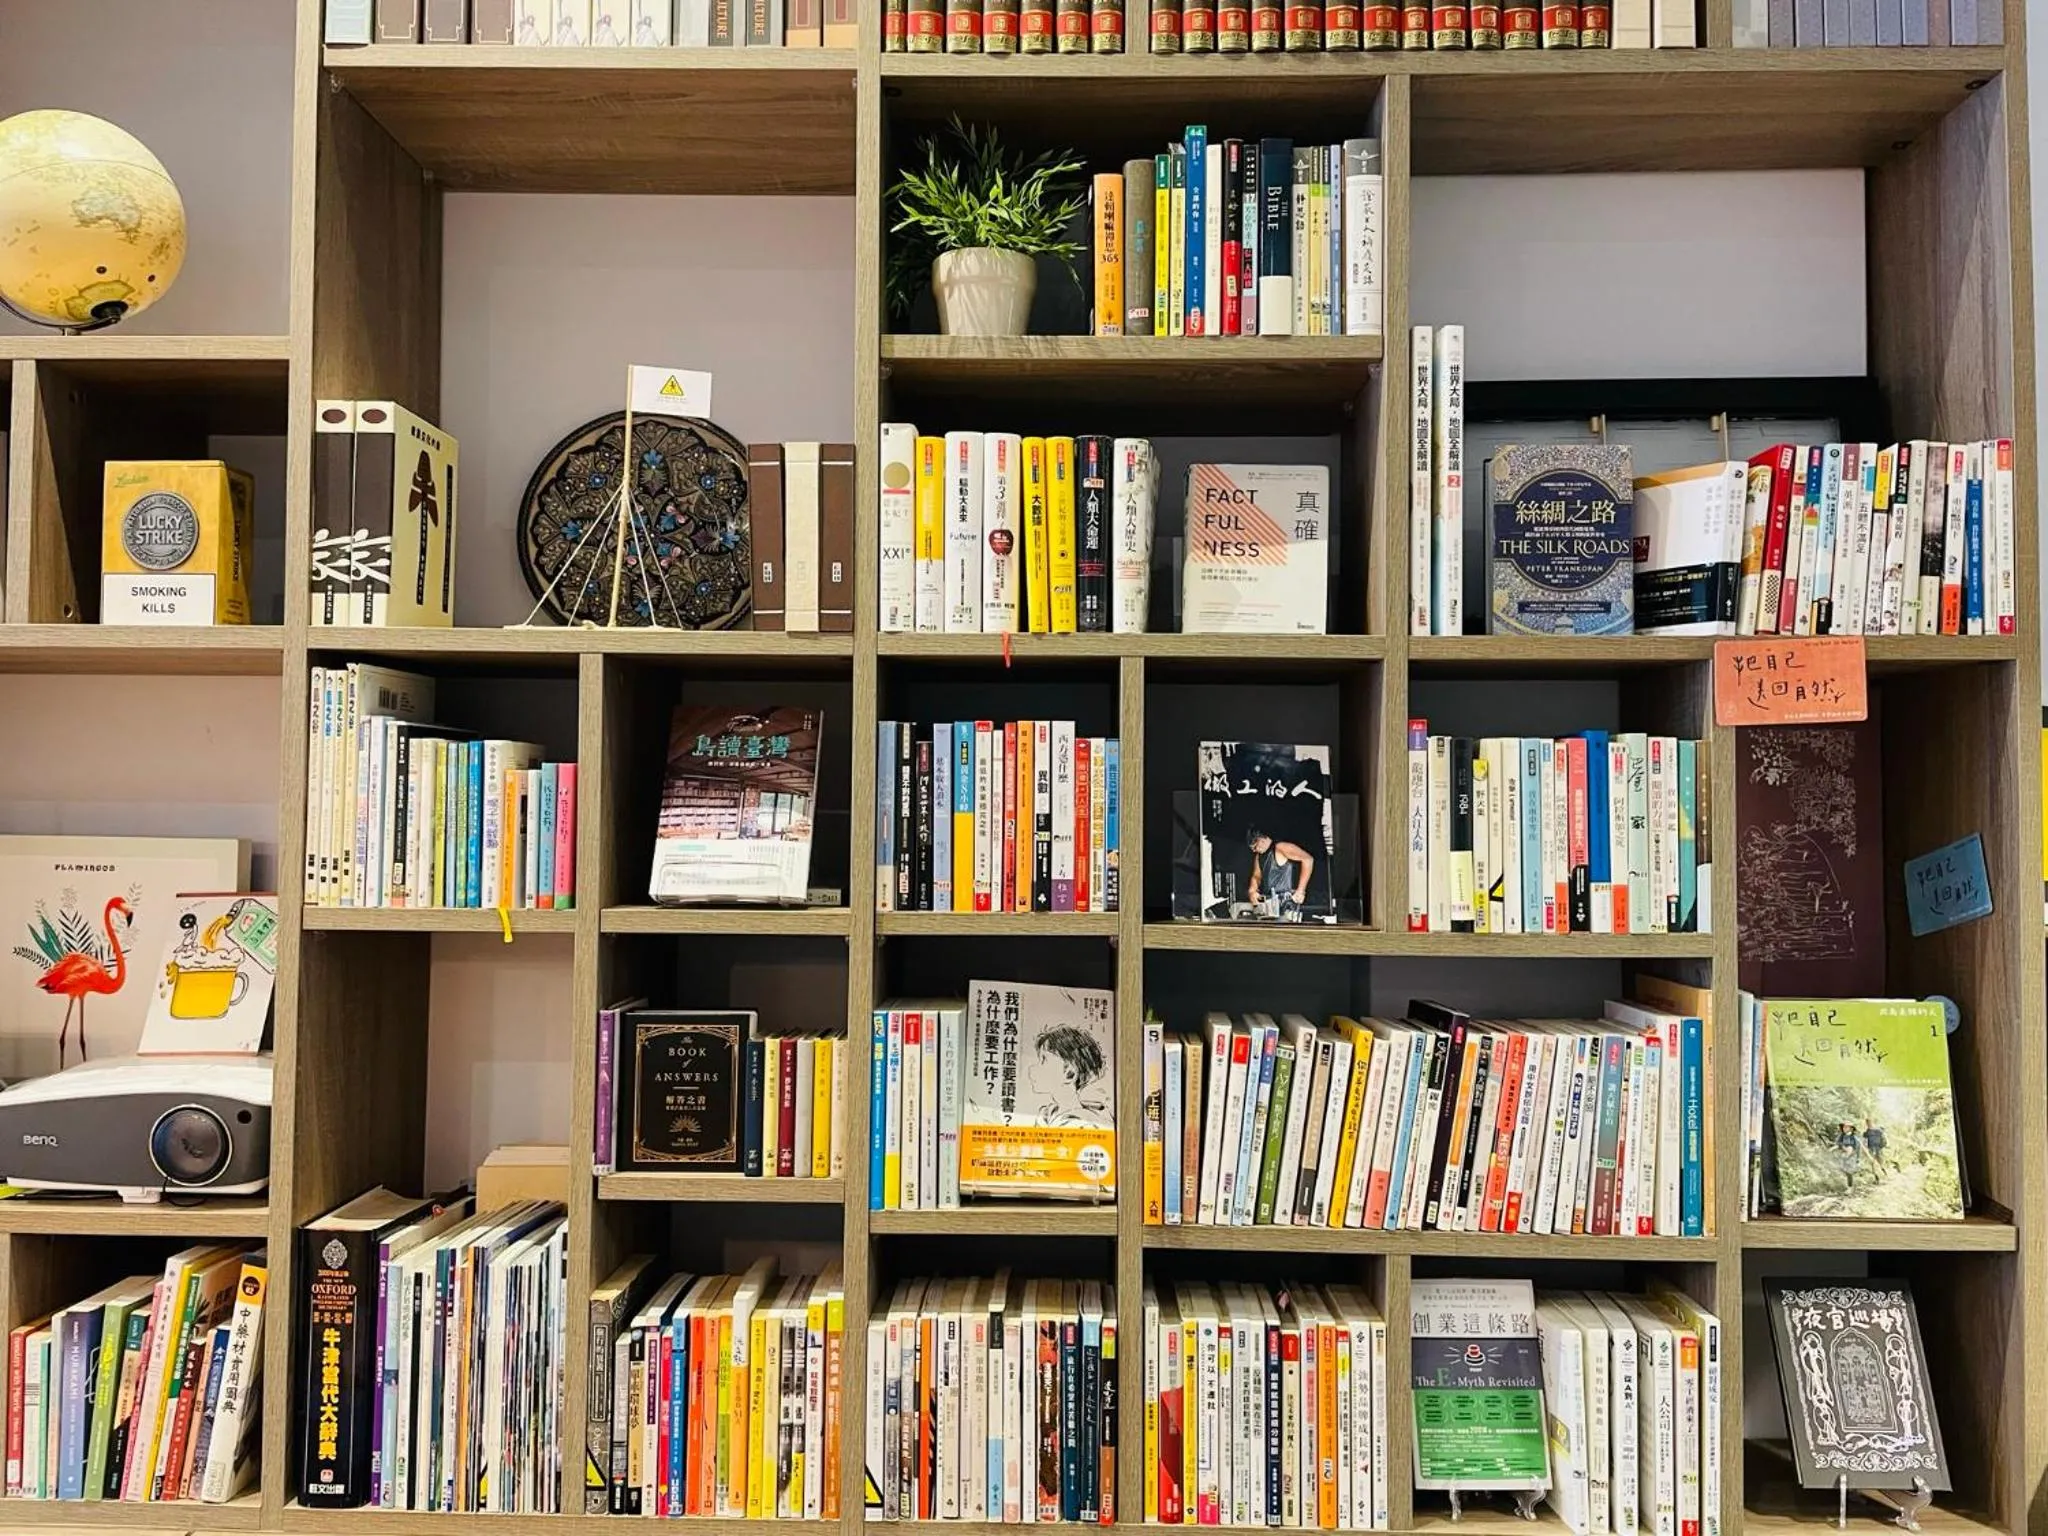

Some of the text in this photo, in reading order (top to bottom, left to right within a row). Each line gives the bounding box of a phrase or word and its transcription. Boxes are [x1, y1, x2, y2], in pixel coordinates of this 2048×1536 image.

[1267, 186, 1279, 231] BIBLE
[1206, 488, 1258, 505] FACT
[1295, 491, 1320, 541] 真確
[1515, 500, 1617, 525] 絲綢之路
[138, 515, 183, 529] LUCKY
[1204, 514, 1245, 531] FUL
[136, 529, 183, 544] STRIKE
[1203, 541, 1260, 558] NESS
[1500, 540, 1630, 559] THE SILK ROADS
[131, 586, 187, 597] SMOKING
[141, 603, 176, 614] KILLS
[1631, 815, 1646, 830] 家
[983, 990, 1001, 1095] 為什麼要工作？
[668, 1047, 707, 1057] BOOK
[1001, 991, 1020, 1127] 我們為什麼要讀書？
[654, 1072, 720, 1083] ANSWERS
[1687, 1099, 1698, 1131] Hotel
[23, 1134, 59, 1147] BenQ
[311, 1284, 357, 1295] OXFORD
[1412, 1311, 1531, 1335] 創業這條路
[69, 1345, 80, 1400] MURAKAMI
[1415, 1367, 1536, 1389] The E-Myth Revisited
[317, 1327, 342, 1461] 牛津當代大辭典
